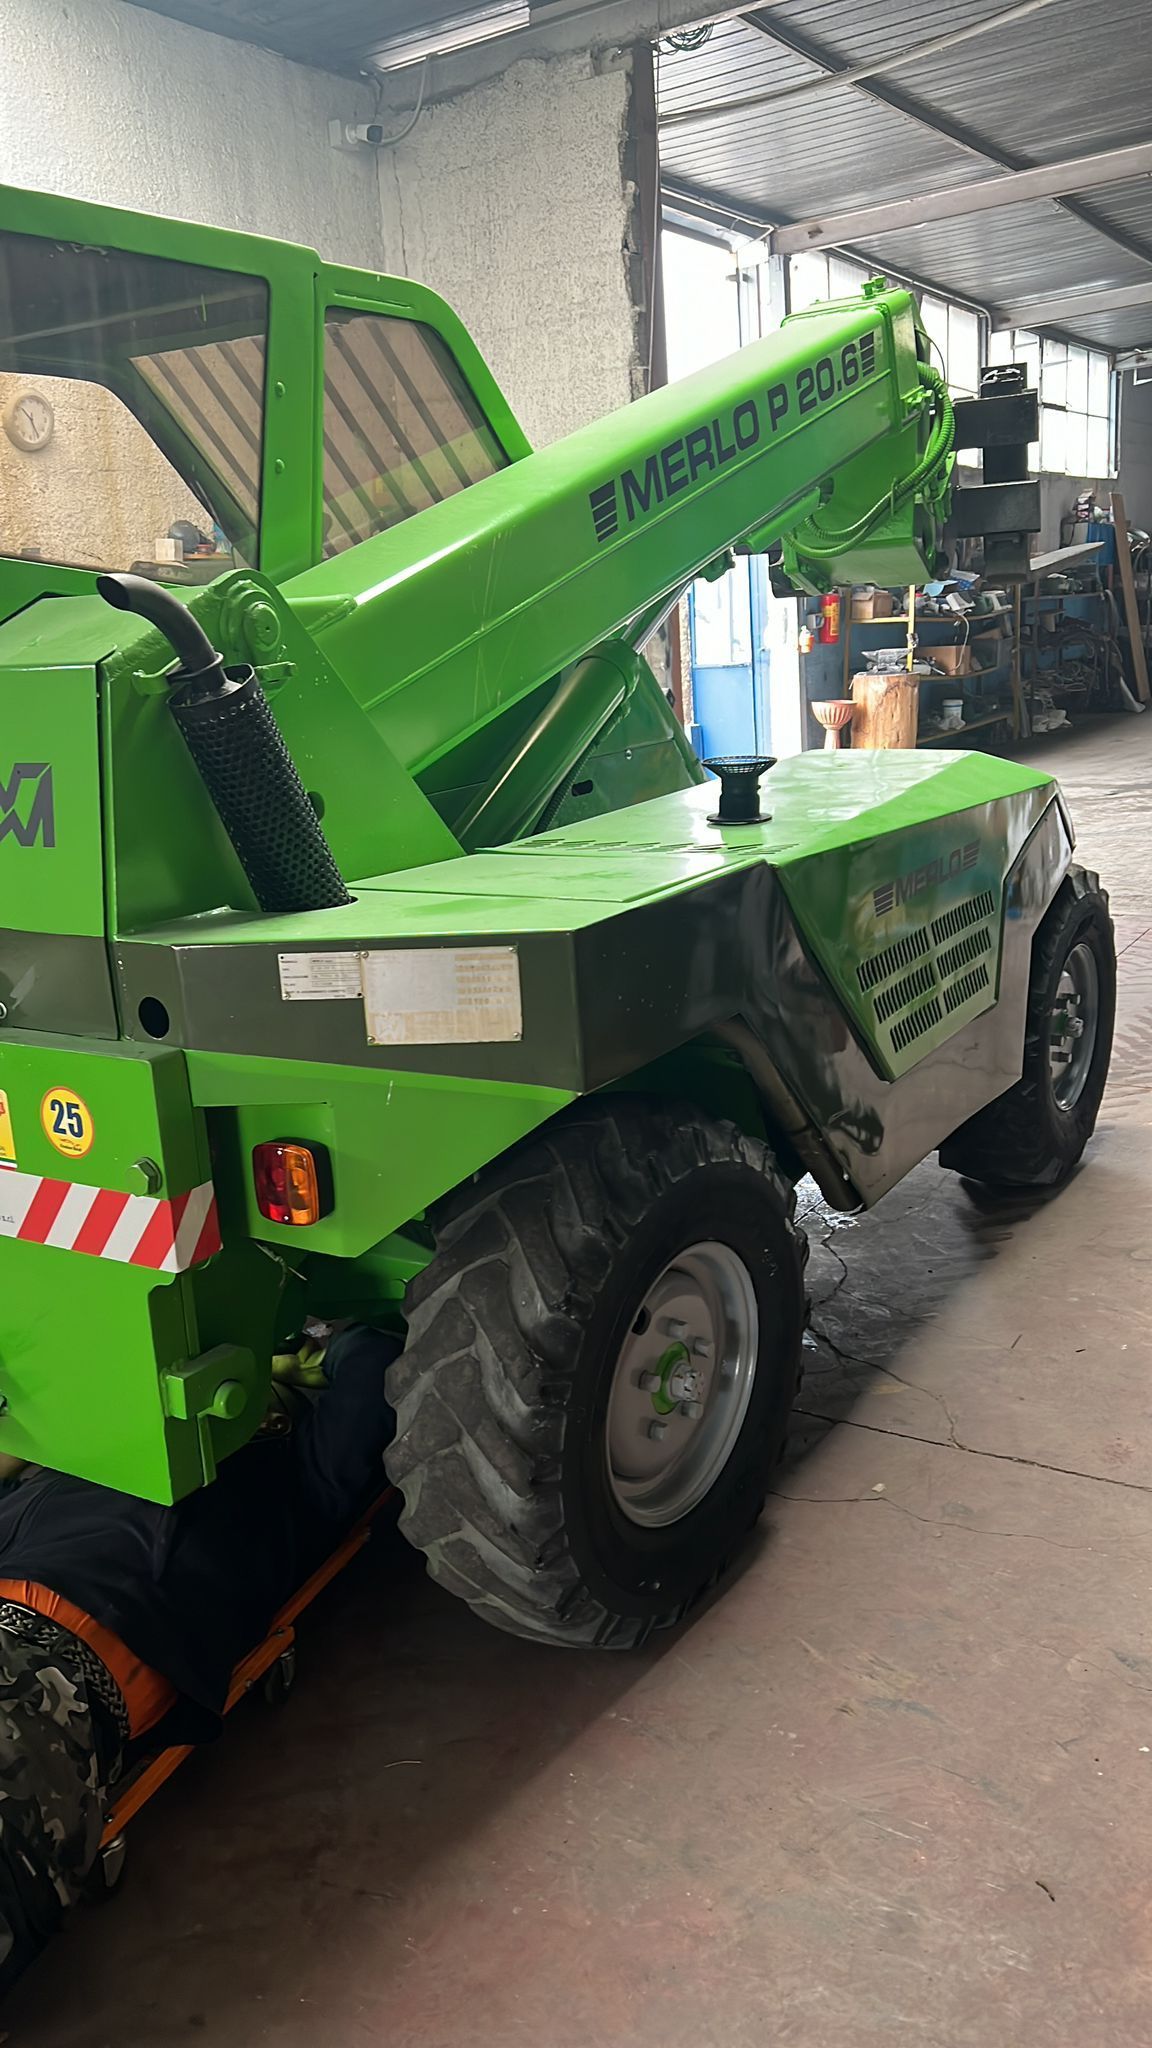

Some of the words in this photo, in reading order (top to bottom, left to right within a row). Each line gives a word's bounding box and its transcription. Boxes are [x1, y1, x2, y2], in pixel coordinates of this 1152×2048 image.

[620, 399, 760, 522] MERLO
[767, 383, 789, 432] P
[796, 343, 860, 415] 20.6
[895, 848, 962, 907] MERLO
[50, 1099, 84, 1138] 25
